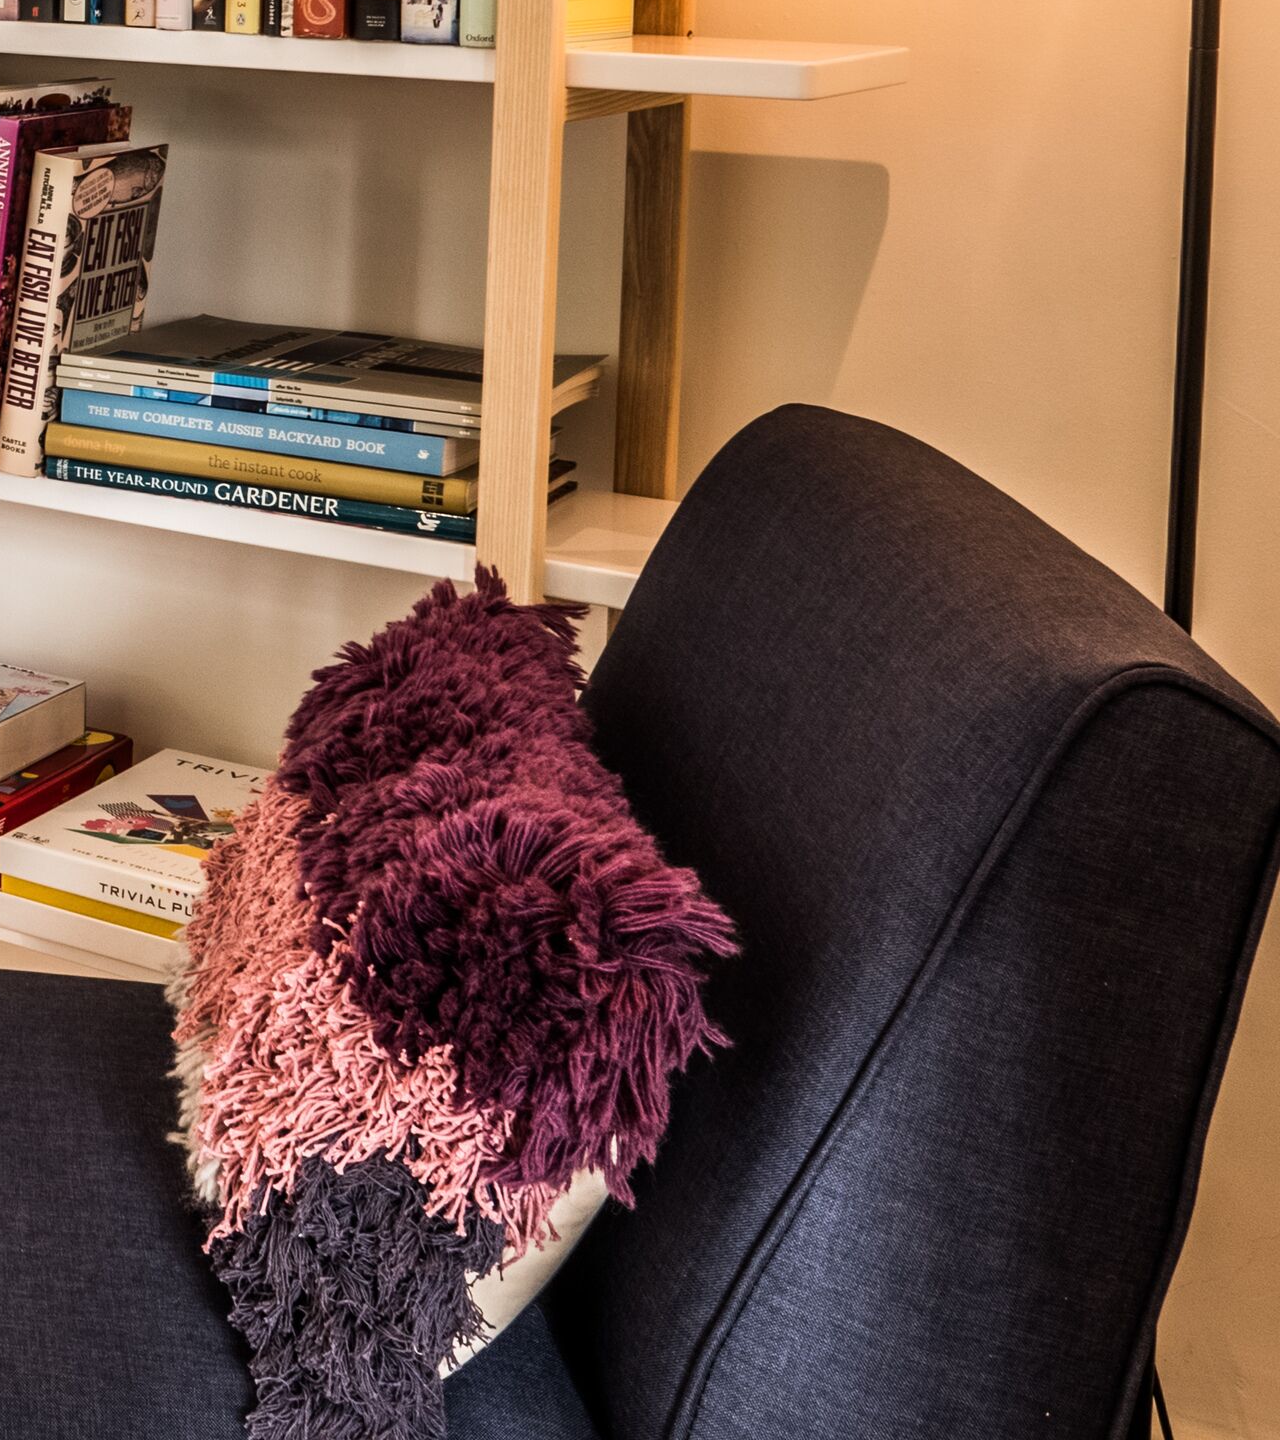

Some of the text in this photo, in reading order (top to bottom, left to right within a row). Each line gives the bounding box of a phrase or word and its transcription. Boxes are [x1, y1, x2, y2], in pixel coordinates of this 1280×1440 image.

[88, 405, 386, 455] THE NEW COMPLETE AUSSIE BACKYARD BOOK
[208, 455, 322, 483] the instant cook
[74, 465, 338, 517] THE YEAR-ROUND GARDENER
[99, 882, 166, 910] TRIVIAL
